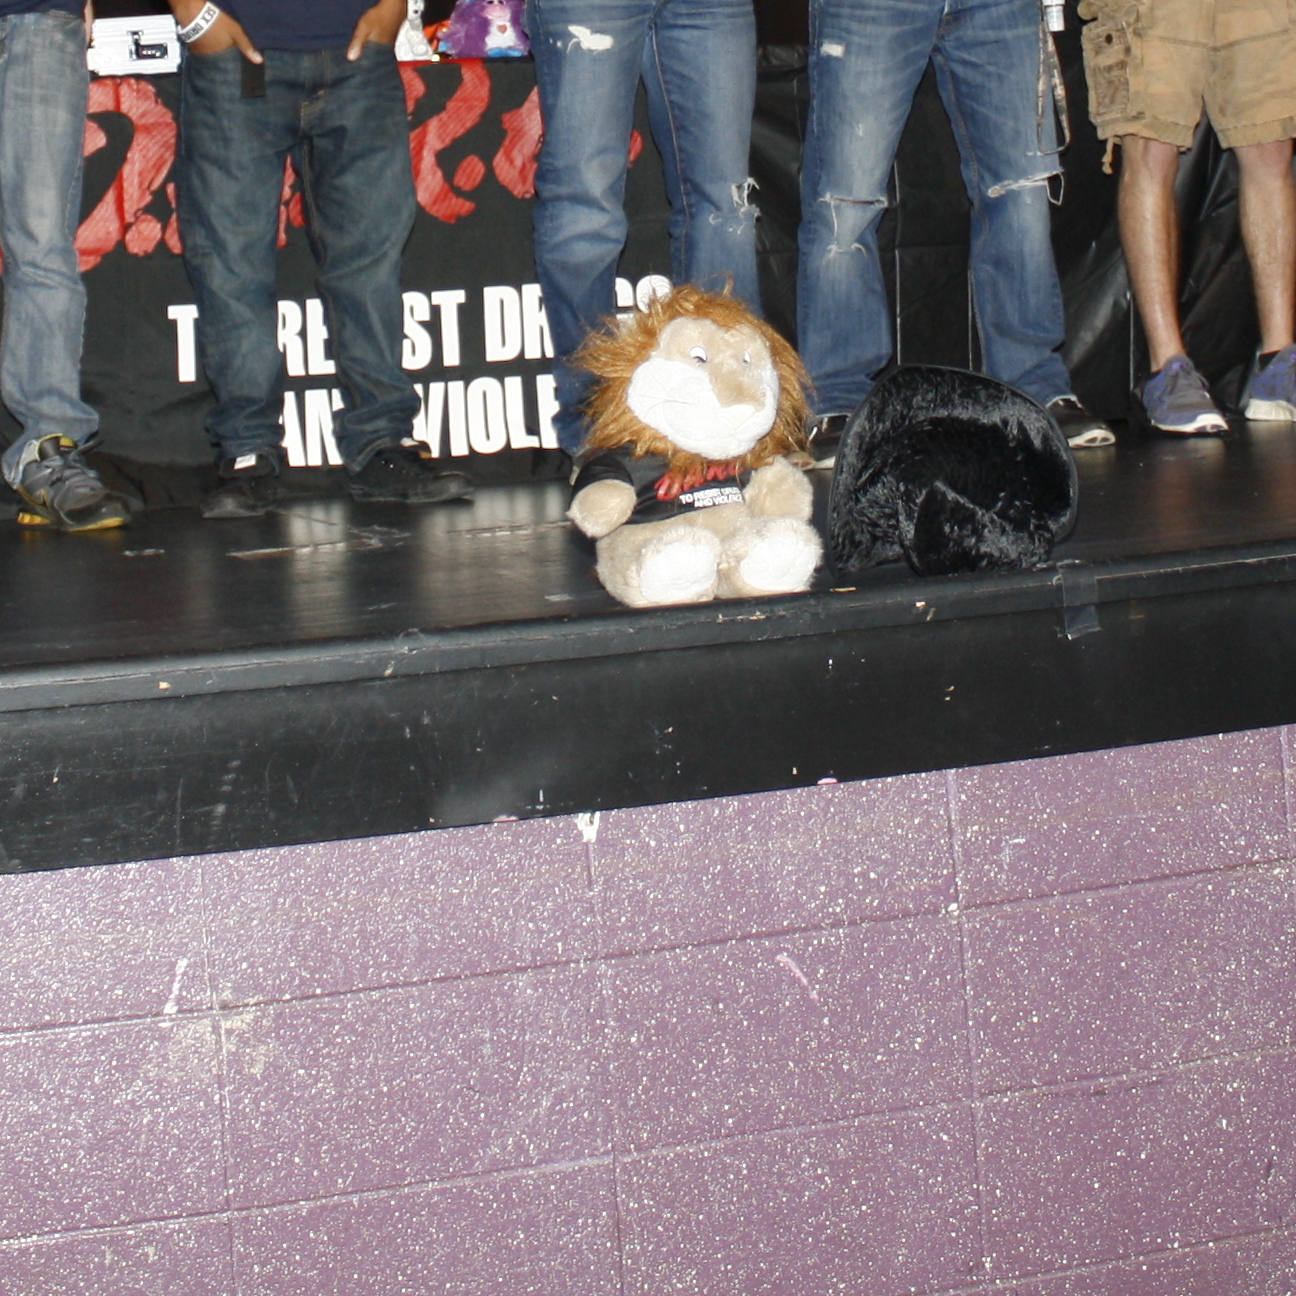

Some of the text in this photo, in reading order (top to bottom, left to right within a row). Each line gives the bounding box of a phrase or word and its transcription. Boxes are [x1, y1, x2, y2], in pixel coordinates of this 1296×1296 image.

[167, 304, 199, 382] T
[277, 289, 465, 377] REST
[278, 373, 561, 467] AN VIOLE
[679, 493, 693, 504] TO
[694, 498, 713, 507] AND
